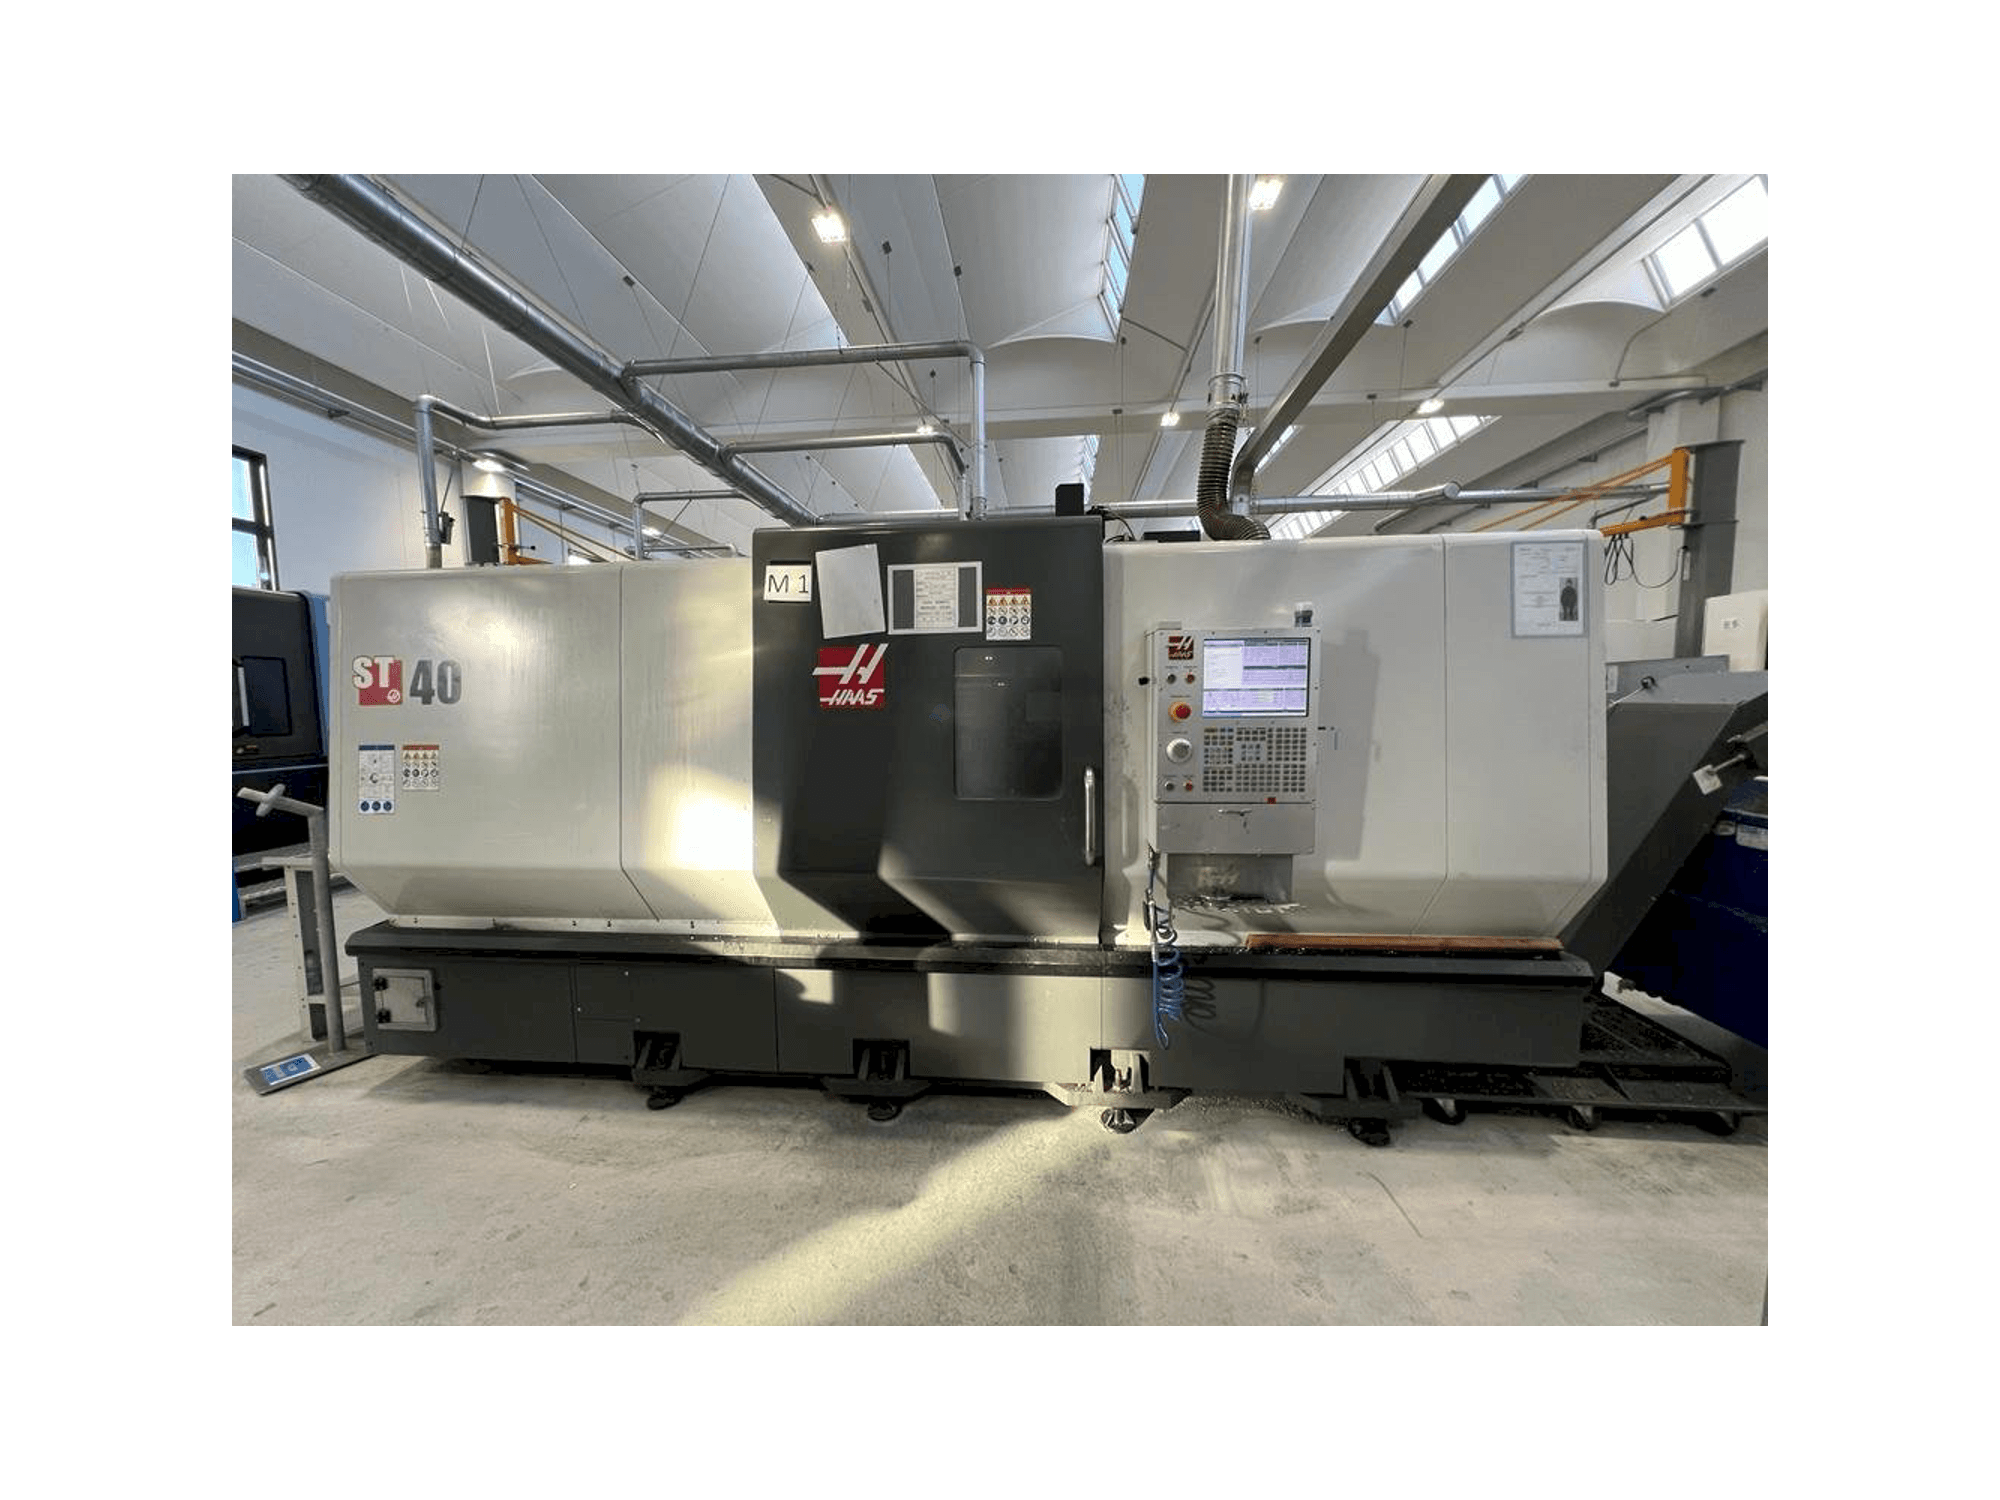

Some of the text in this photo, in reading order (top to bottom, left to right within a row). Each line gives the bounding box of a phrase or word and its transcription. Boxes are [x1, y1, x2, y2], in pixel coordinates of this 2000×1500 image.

[768, 574, 809, 593] M 1
[352, 655, 462, 705] ST 40
[819, 688, 885, 705] HAAS
